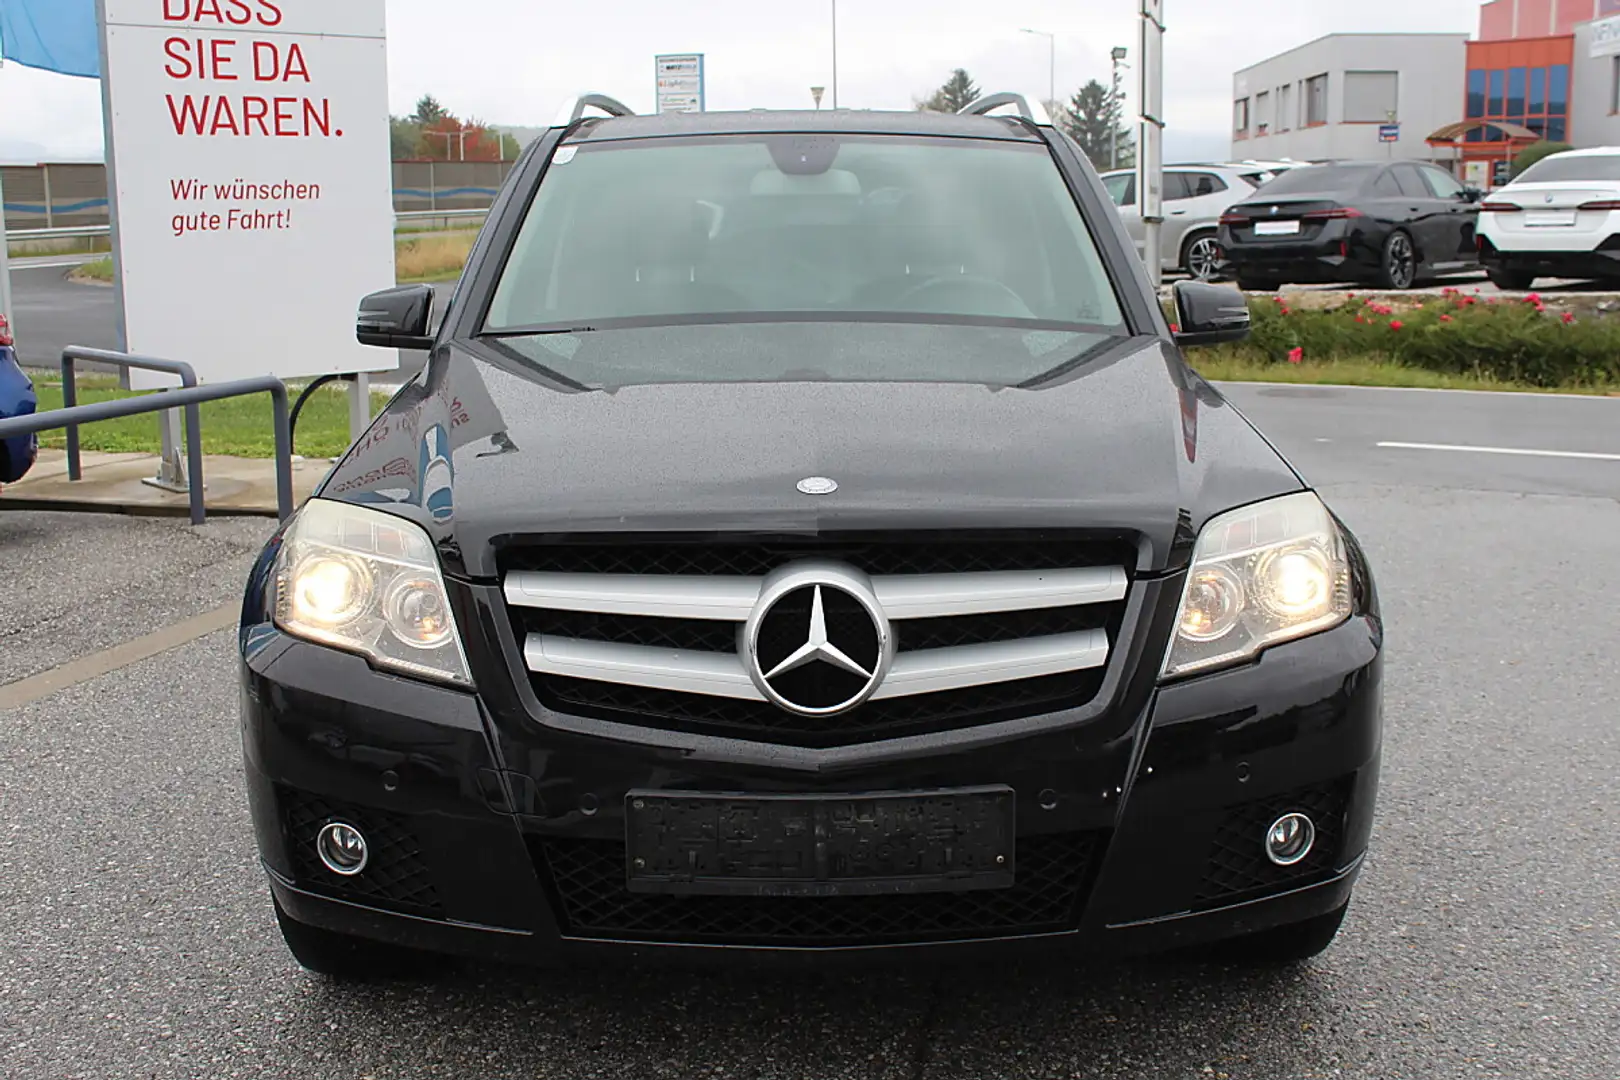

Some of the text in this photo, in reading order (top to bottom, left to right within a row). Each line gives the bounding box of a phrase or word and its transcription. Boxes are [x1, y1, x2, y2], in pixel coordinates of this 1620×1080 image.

[164, 37, 311, 83] SIE DA
[165, 94, 344, 137] WAREN.
[170, 178, 320, 202] Wir wünschen
[172, 208, 292, 237] gute Fahrt!
